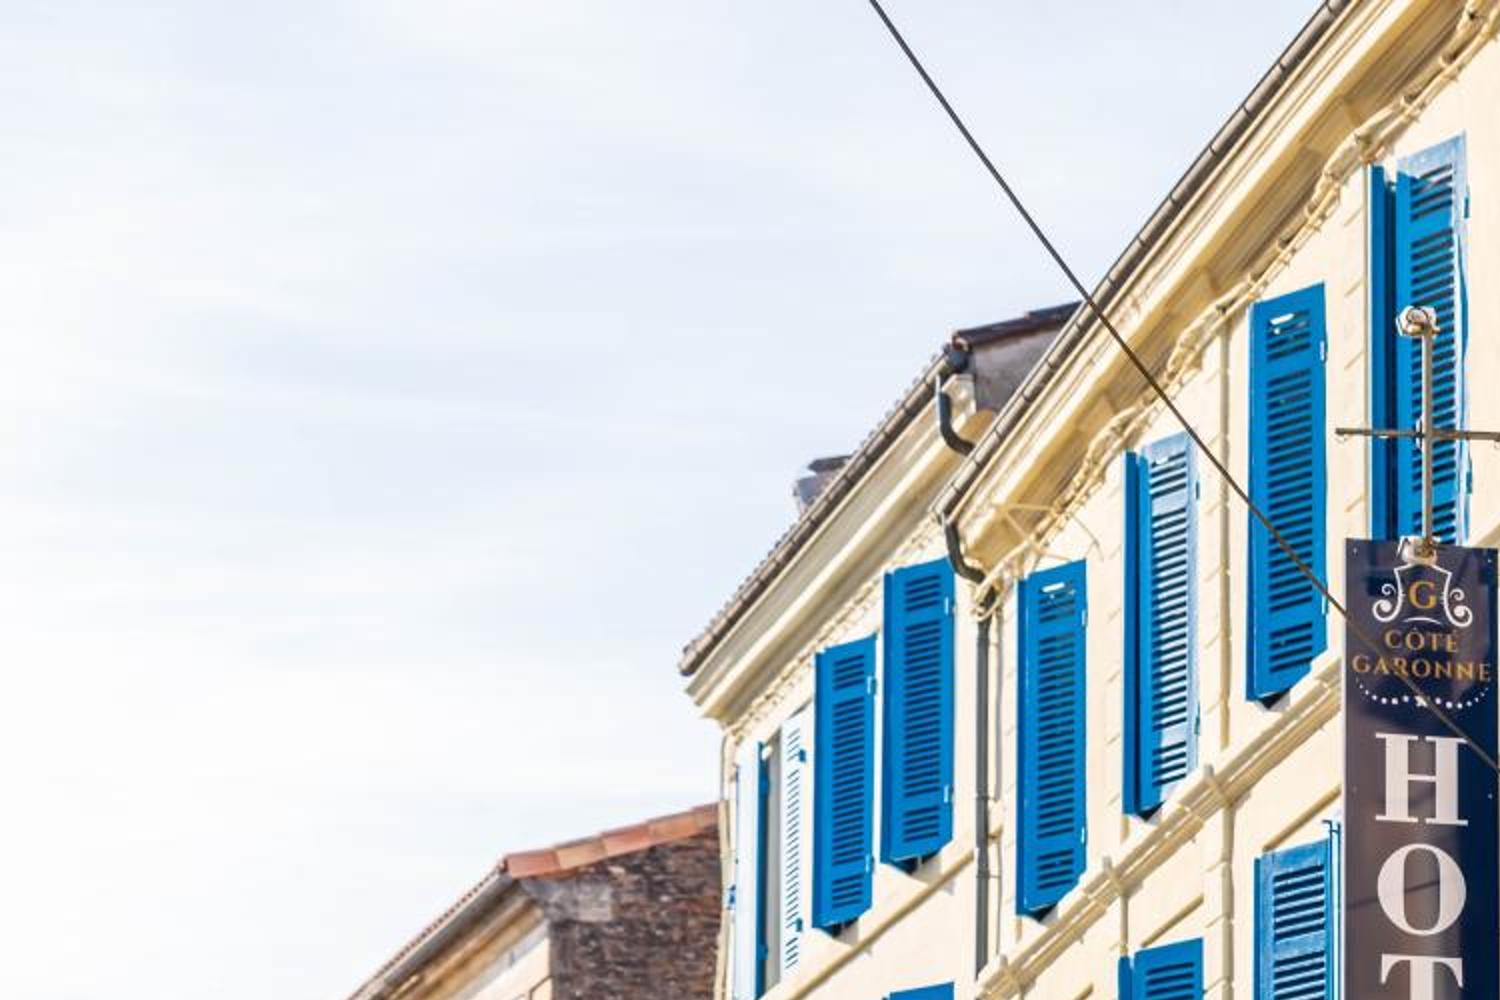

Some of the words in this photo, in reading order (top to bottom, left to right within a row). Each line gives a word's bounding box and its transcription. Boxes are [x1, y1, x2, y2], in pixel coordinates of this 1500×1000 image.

[1408, 581, 1437, 609] G
[1384, 626, 1458, 653] CÔTÉ
[1352, 655, 1491, 682] GARONNE
